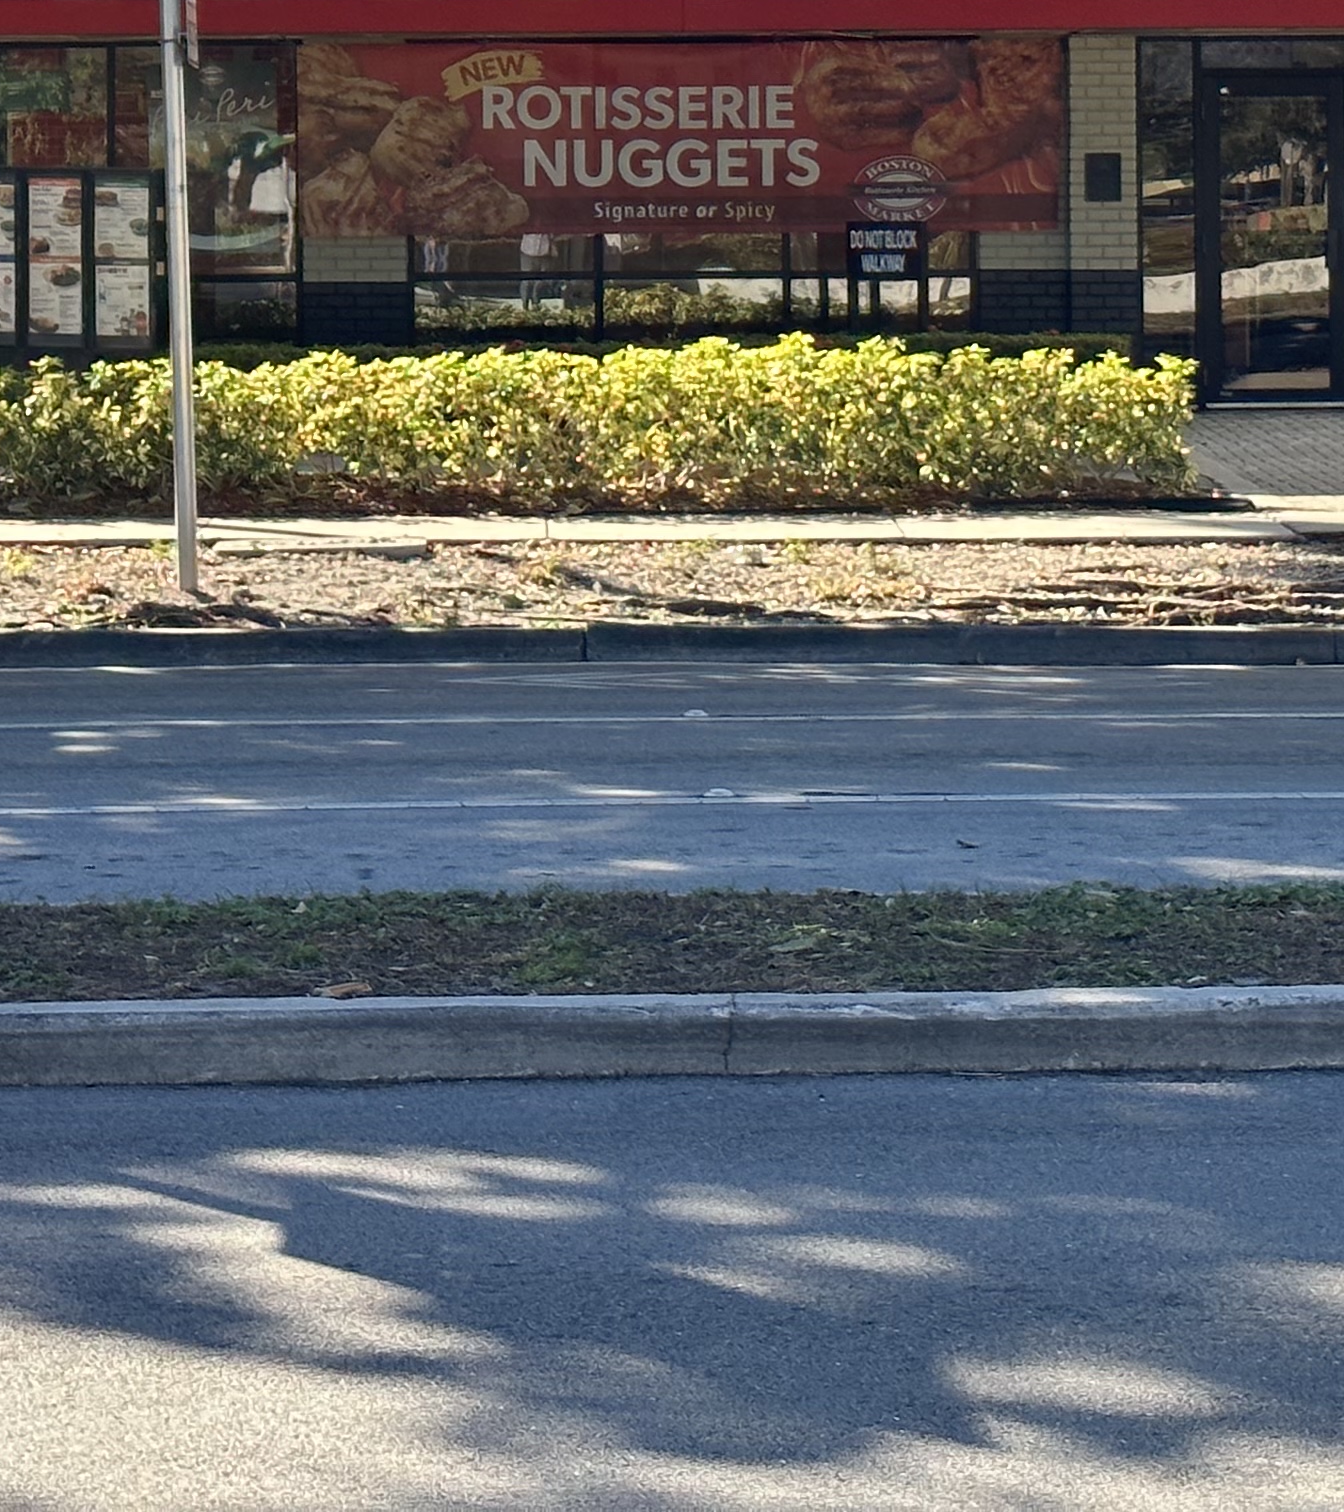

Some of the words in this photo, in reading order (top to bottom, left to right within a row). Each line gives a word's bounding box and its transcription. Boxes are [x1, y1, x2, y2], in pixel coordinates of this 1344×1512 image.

[458, 54, 525, 86] NEW
[216, 81, 274, 123] Peri
[481, 85, 796, 131] ROTISSERIE
[523, 138, 821, 188] NUGGETS
[864, 159, 935, 180] BOSTON
[594, 201, 688, 223] Signature
[696, 204, 718, 218] or
[724, 201, 776, 222] Spicy
[867, 201, 936, 221] MARKET
[850, 229, 864, 249] DO
[864, 229, 884, 249] NOT
[884, 229, 918, 249] BLOCK
[860, 254, 906, 273] WALKWAY
